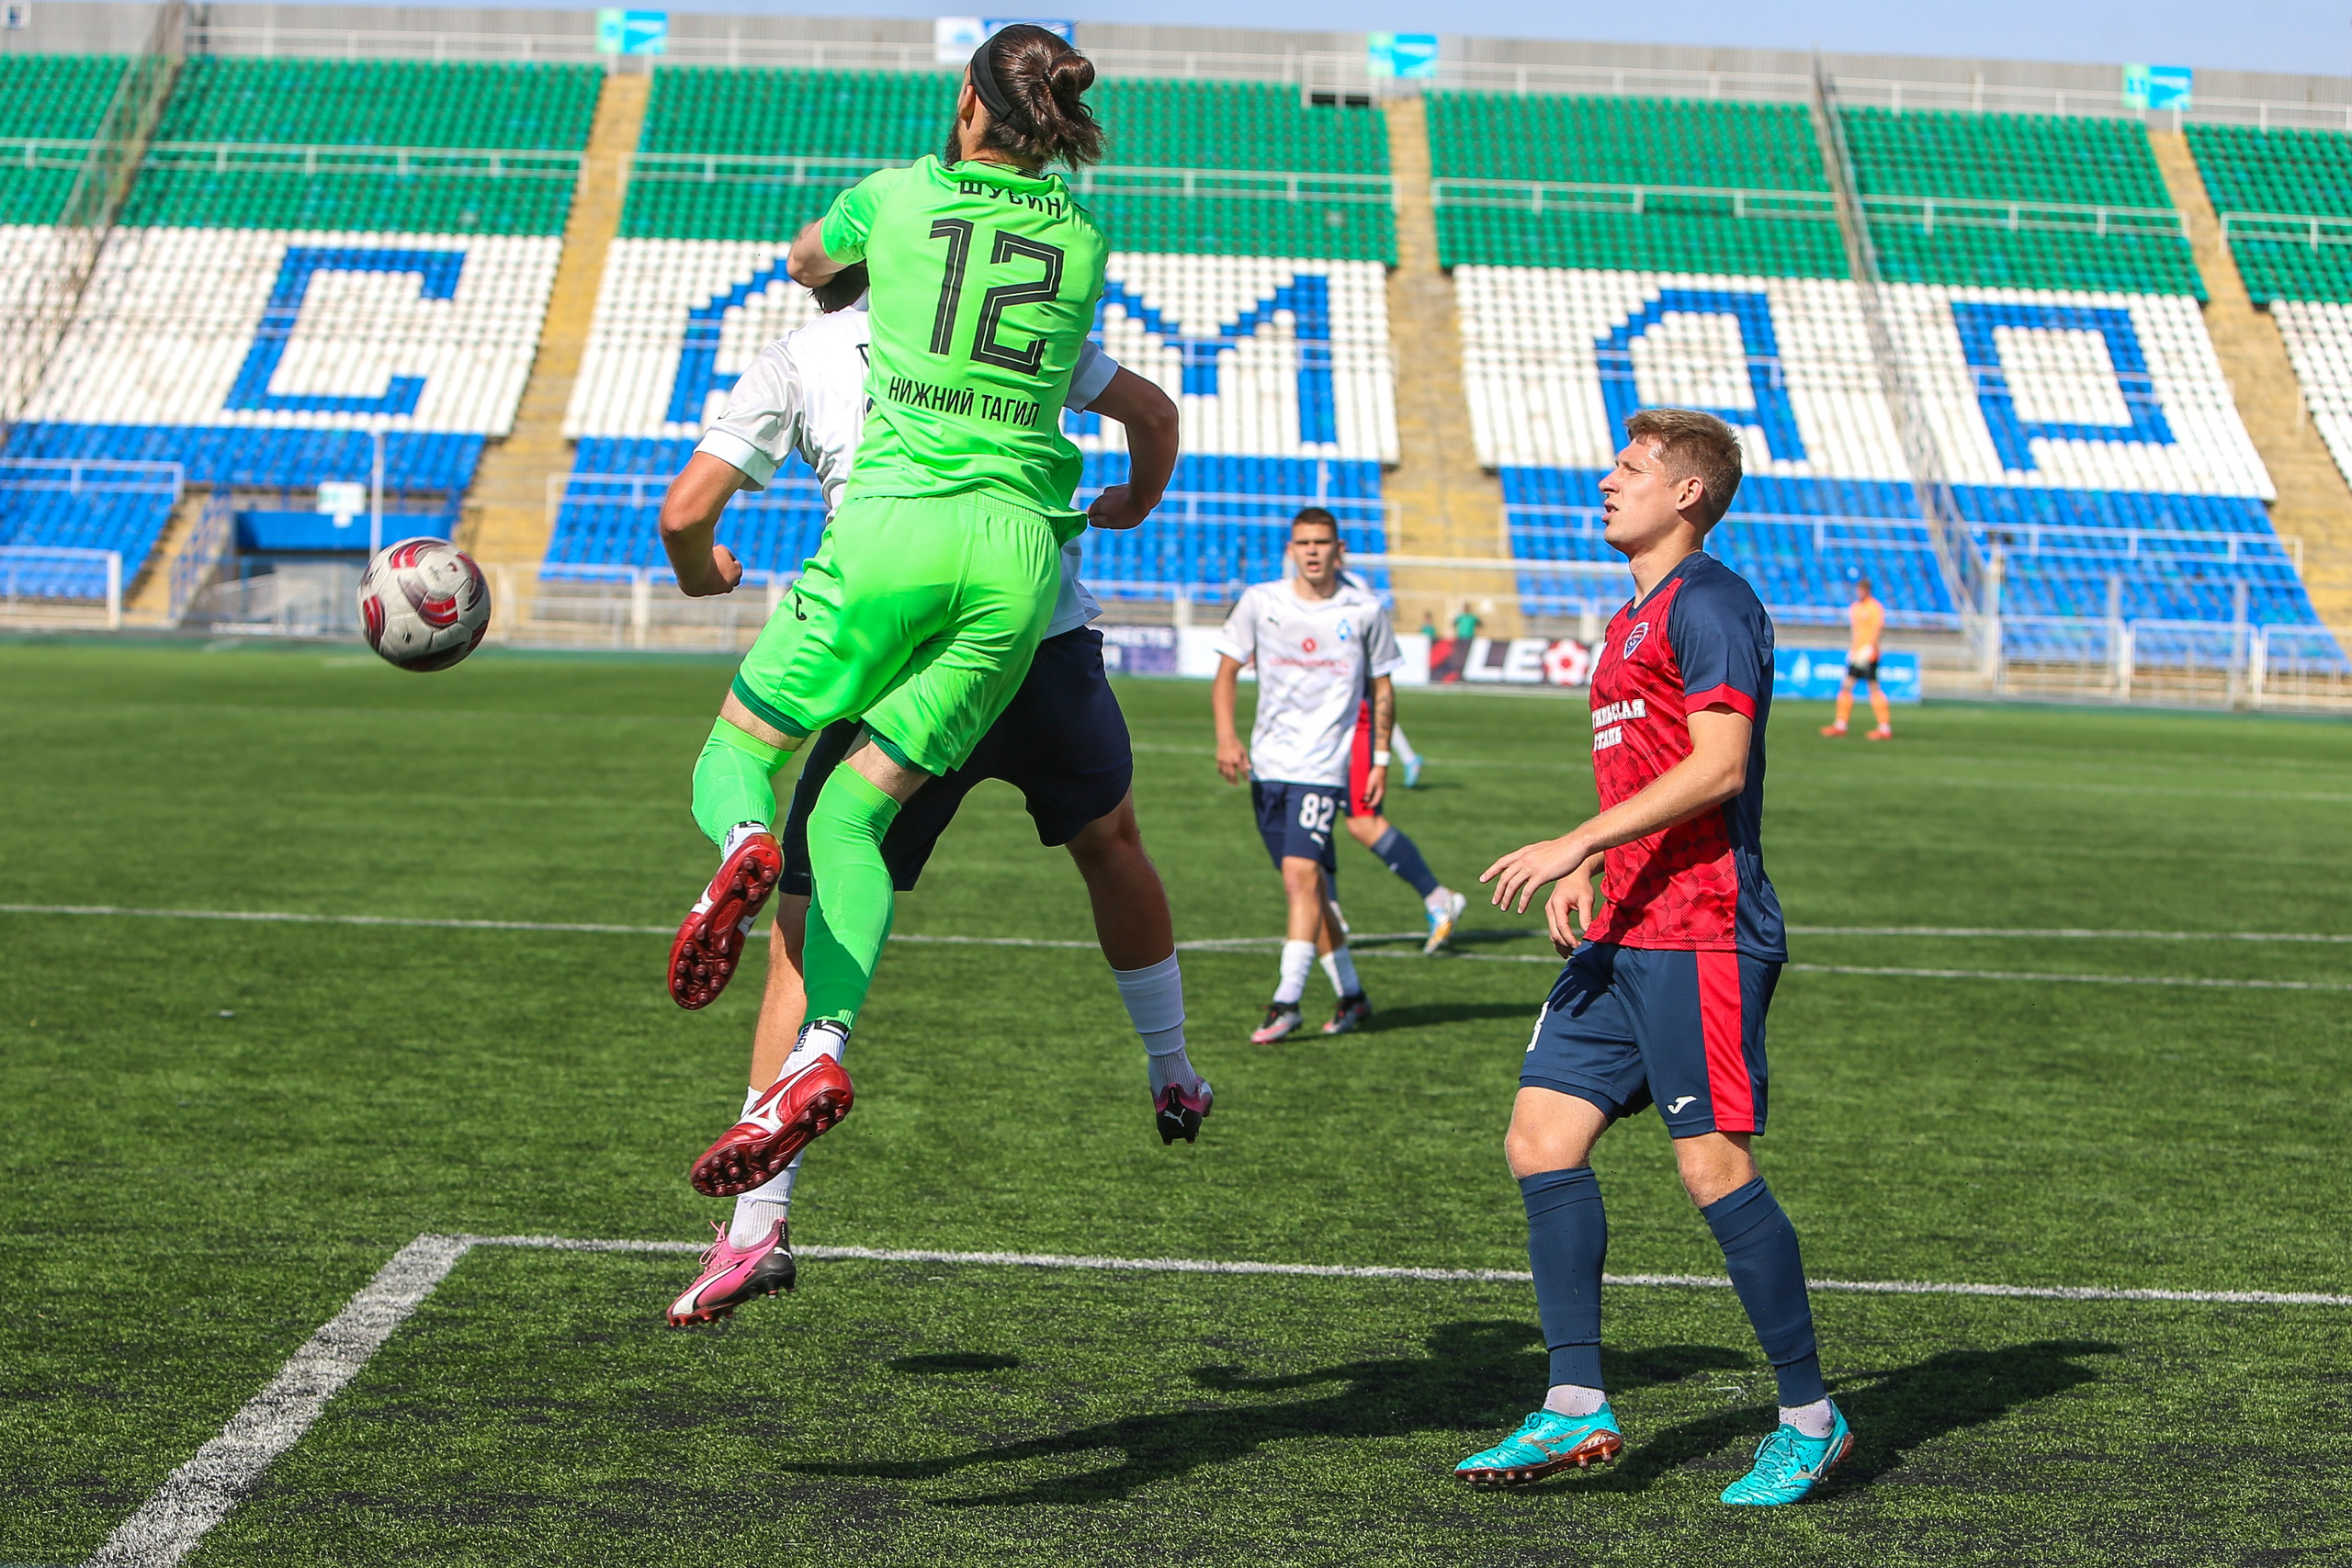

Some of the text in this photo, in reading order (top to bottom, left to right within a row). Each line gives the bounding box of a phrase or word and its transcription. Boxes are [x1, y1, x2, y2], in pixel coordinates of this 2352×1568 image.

[929, 218, 1065, 378] 12
[888, 376, 1041, 428] НИЖНИЙ ТАГИЛ
[1298, 792, 1335, 834] 82
